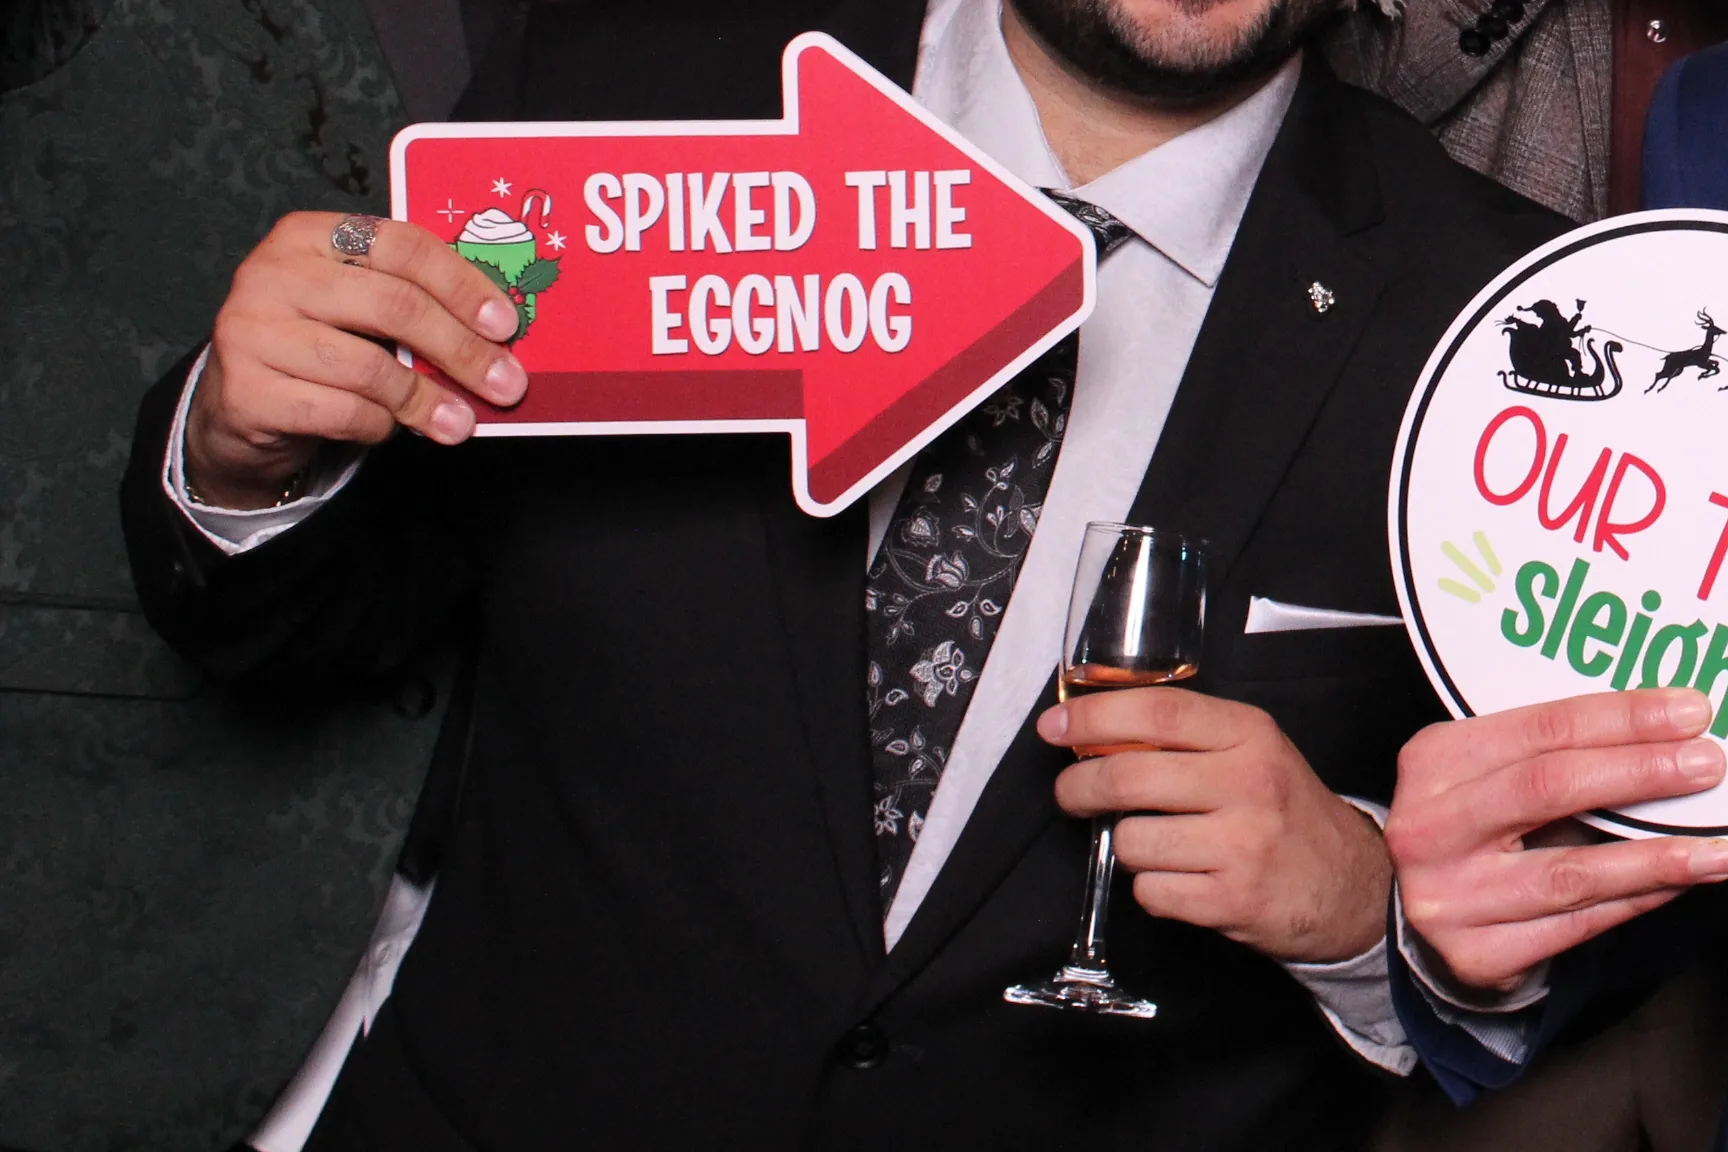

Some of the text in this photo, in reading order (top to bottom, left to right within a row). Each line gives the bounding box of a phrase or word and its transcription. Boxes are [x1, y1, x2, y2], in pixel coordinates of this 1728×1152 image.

[584, 169, 972, 253] SPIKED THE
[650, 273, 912, 355] EGGNOG
[1474, 406, 1667, 561] OUR
